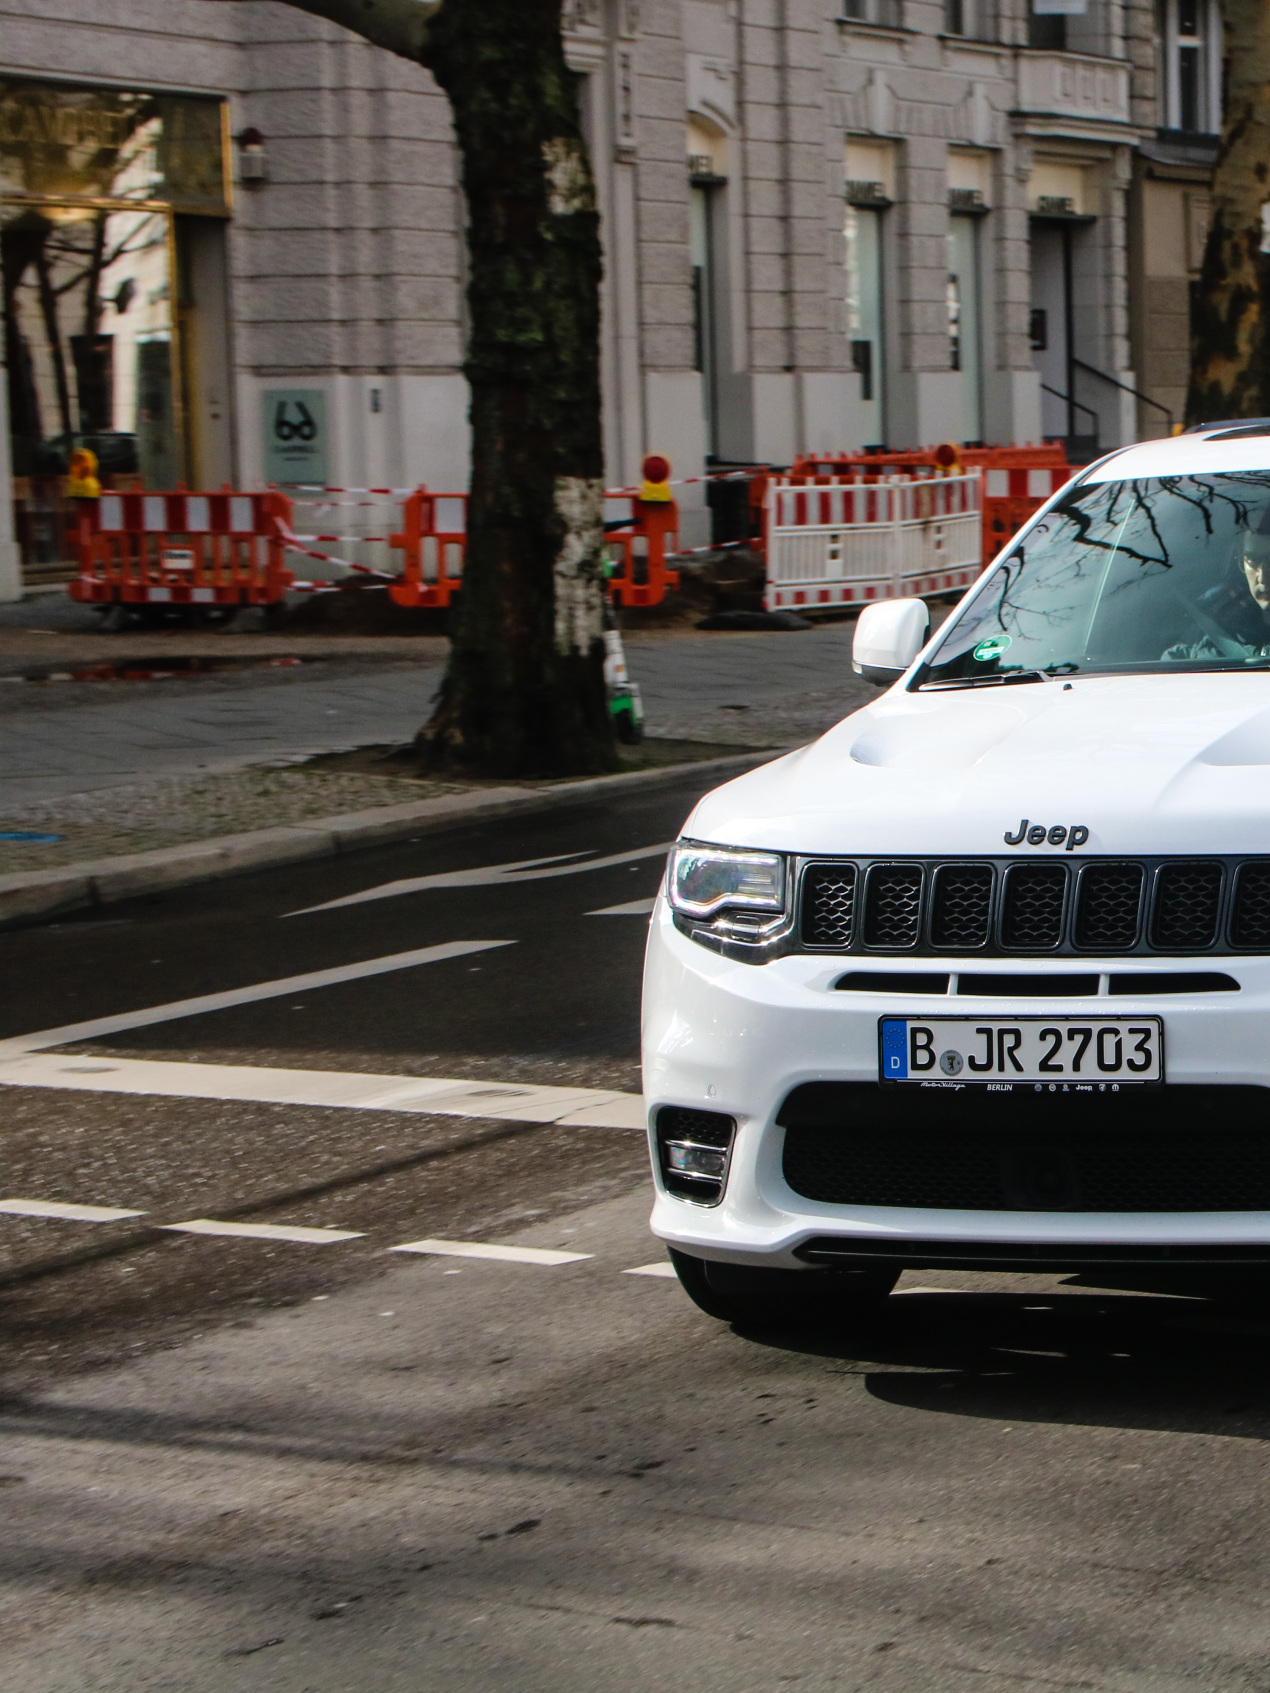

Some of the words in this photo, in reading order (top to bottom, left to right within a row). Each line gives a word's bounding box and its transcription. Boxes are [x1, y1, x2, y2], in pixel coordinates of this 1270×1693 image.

[1004, 819, 1089, 851] Jeep
[910, 1027, 936, 1071] B
[968, 1027, 1024, 1072] JR
[1038, 1027, 1152, 1072] 2703
[891, 1056, 900, 1069] D
[986, 1083, 1013, 1091] BERLIN
